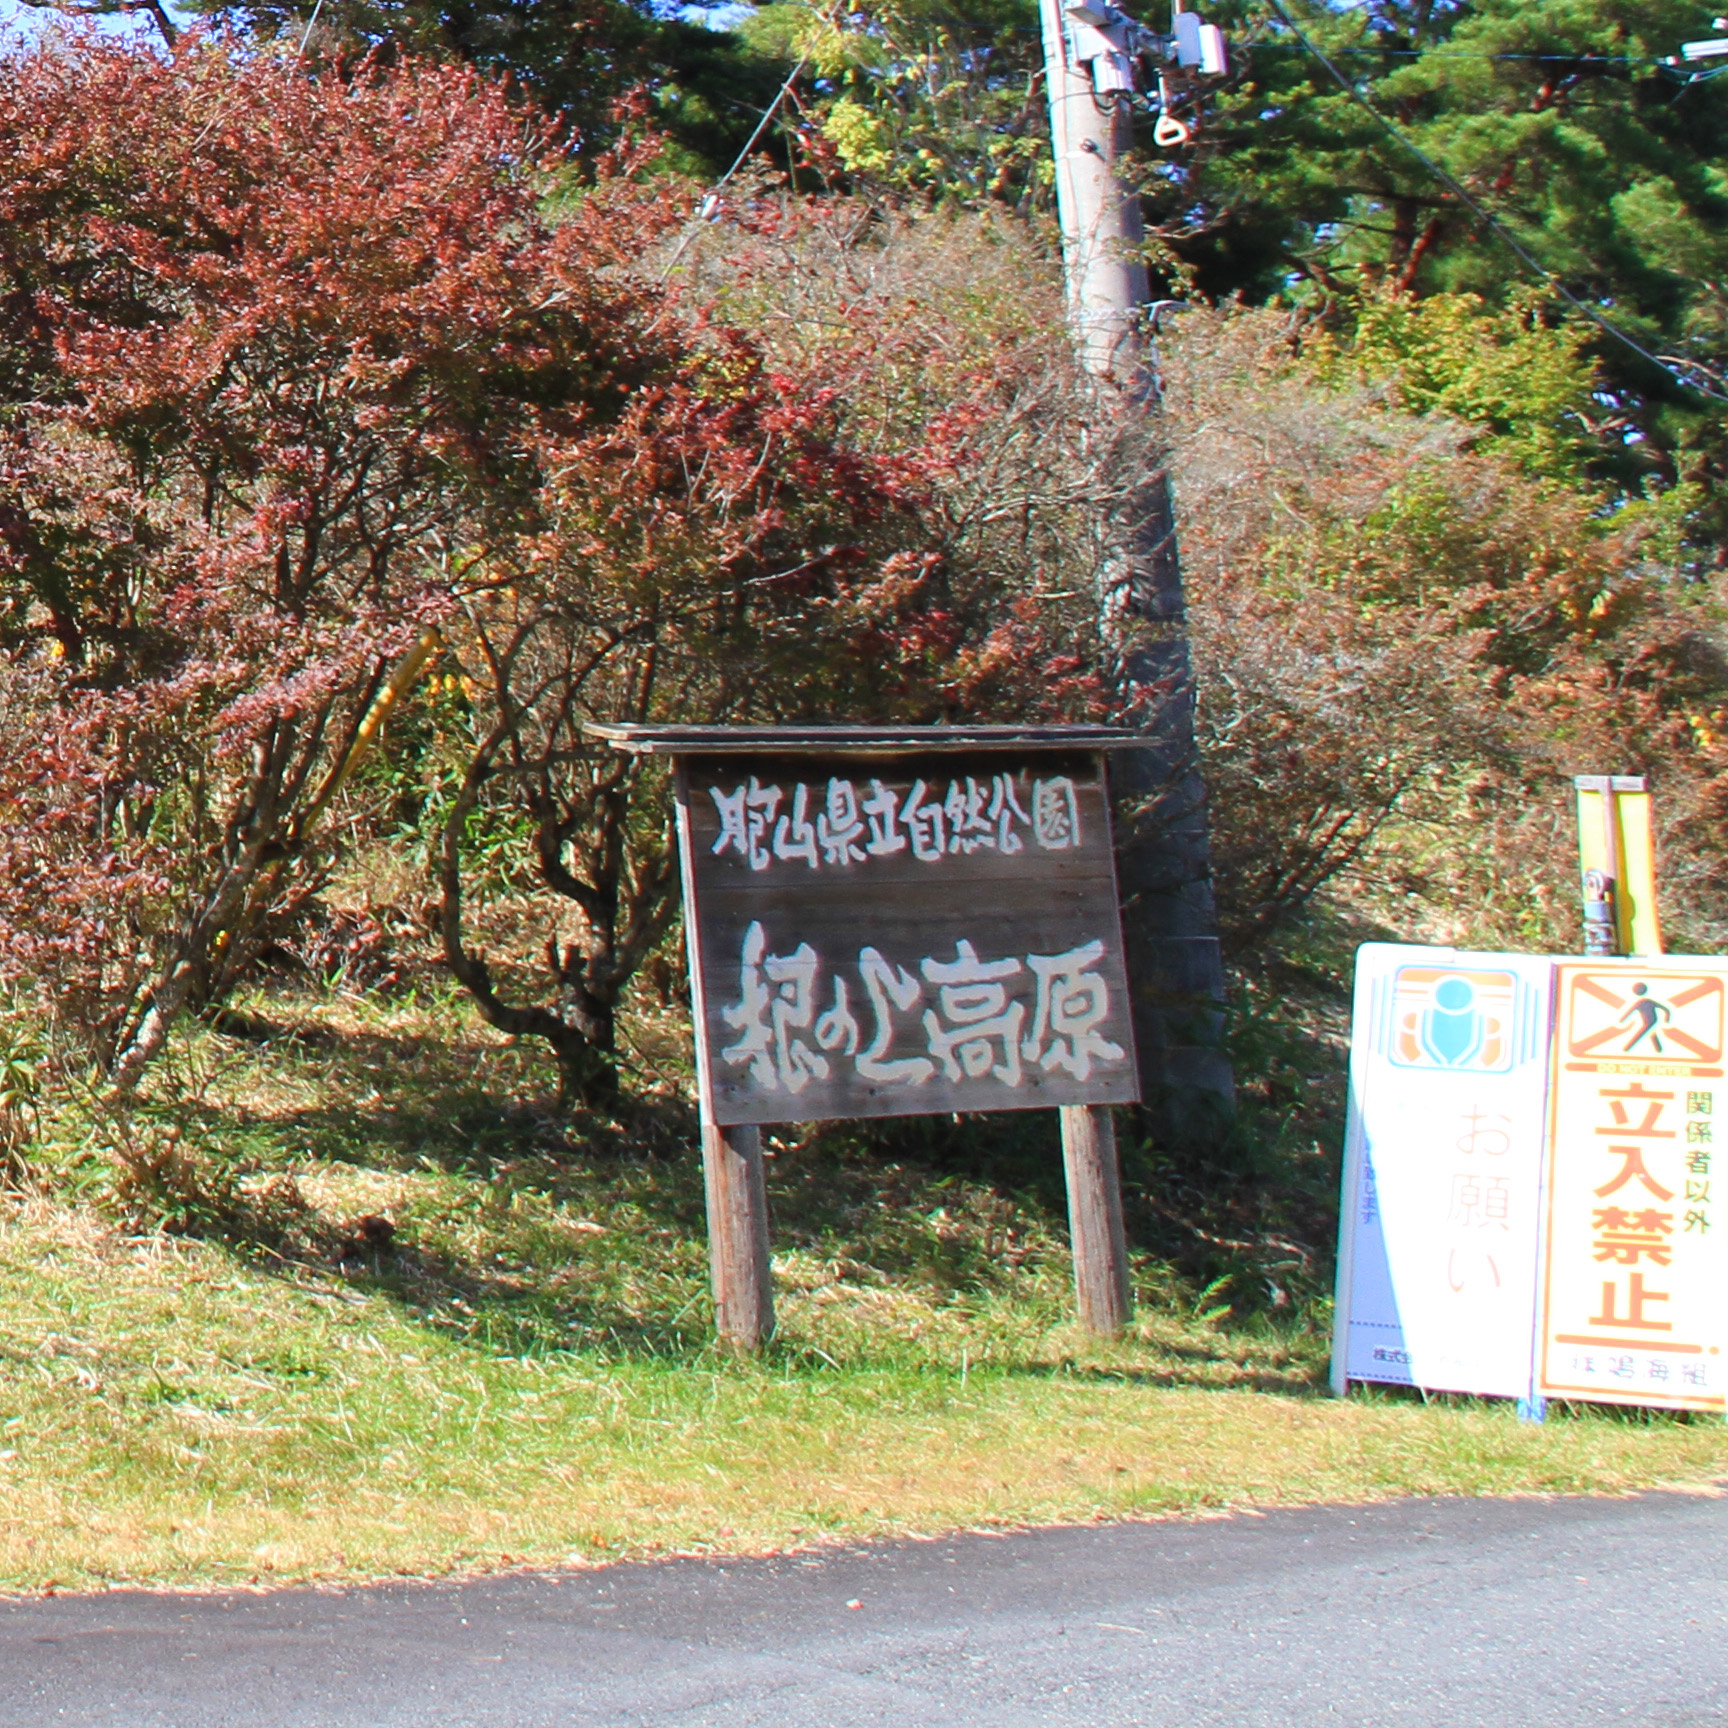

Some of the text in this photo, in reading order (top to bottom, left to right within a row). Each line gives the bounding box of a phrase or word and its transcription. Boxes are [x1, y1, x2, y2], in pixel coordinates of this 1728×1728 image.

[708, 773, 1081, 871] 胞山県立自然公園
[720, 921, 1124, 1093] 根の上高原
[1597, 1063, 1691, 1076] DO NOT ENTER
[1447, 1105, 1513, 1294] お願い
[1588, 1082, 1677, 1331] 立入禁止
[1684, 1091, 1713, 1235] 関係者以外
